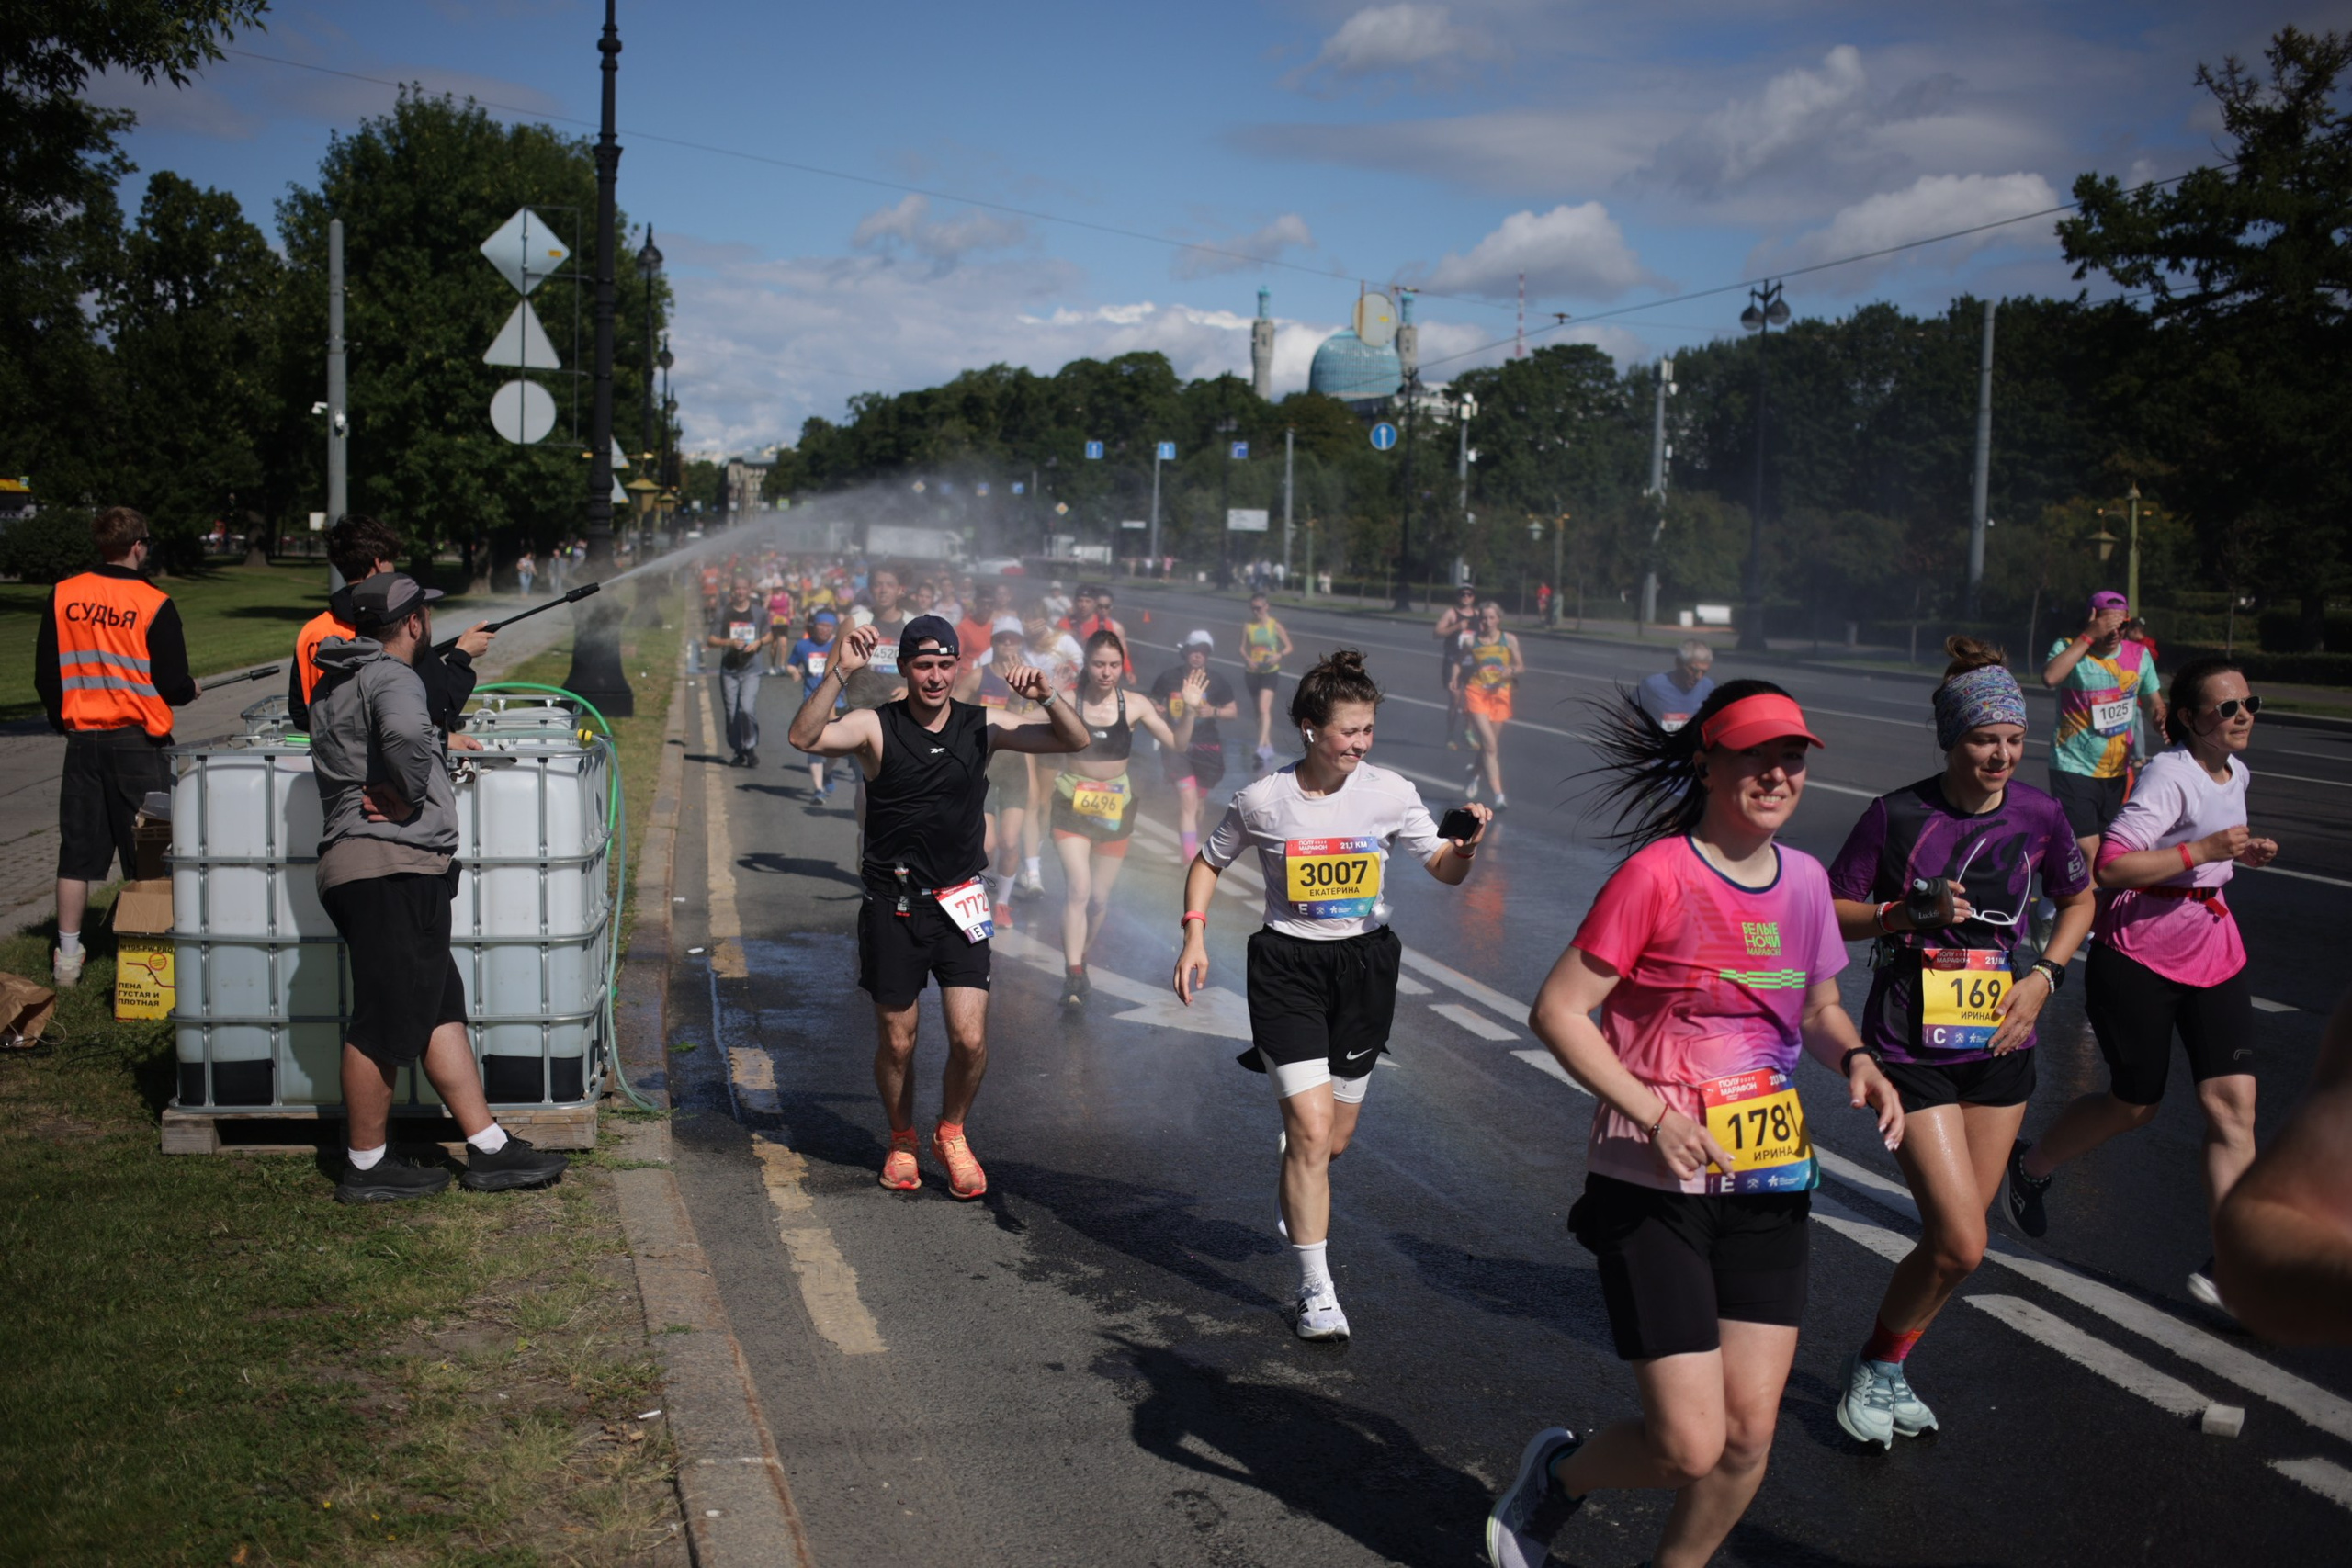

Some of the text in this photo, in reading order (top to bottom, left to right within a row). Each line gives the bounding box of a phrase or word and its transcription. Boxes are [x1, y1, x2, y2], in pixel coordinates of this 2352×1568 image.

[65, 602, 137, 630] СУДЬЯ
[2100, 702, 2129, 720] 1025
[1080, 795, 1116, 811] 6496
[1340, 840, 1367, 850] 21,1 КМ
[1300, 860, 1368, 887] 3007
[1309, 886, 1360, 897] ЕКАТЕРИНА
[1742, 922, 1779, 935] БЕЛЫЕ
[1745, 935, 1781, 948] НОЧИ
[1747, 947, 1781, 955] МАРАФОН
[118, 990, 151, 998] ГУСТАЯ
[1951, 978, 2001, 1009] 169
[118, 998, 160, 1007] ПЛОТНАЯ
[1961, 1011, 1991, 1020] ИРИНА
[1720, 1082, 1757, 1096] МАРАФОН
[1754, 1145, 1793, 1161] ИРИНА
